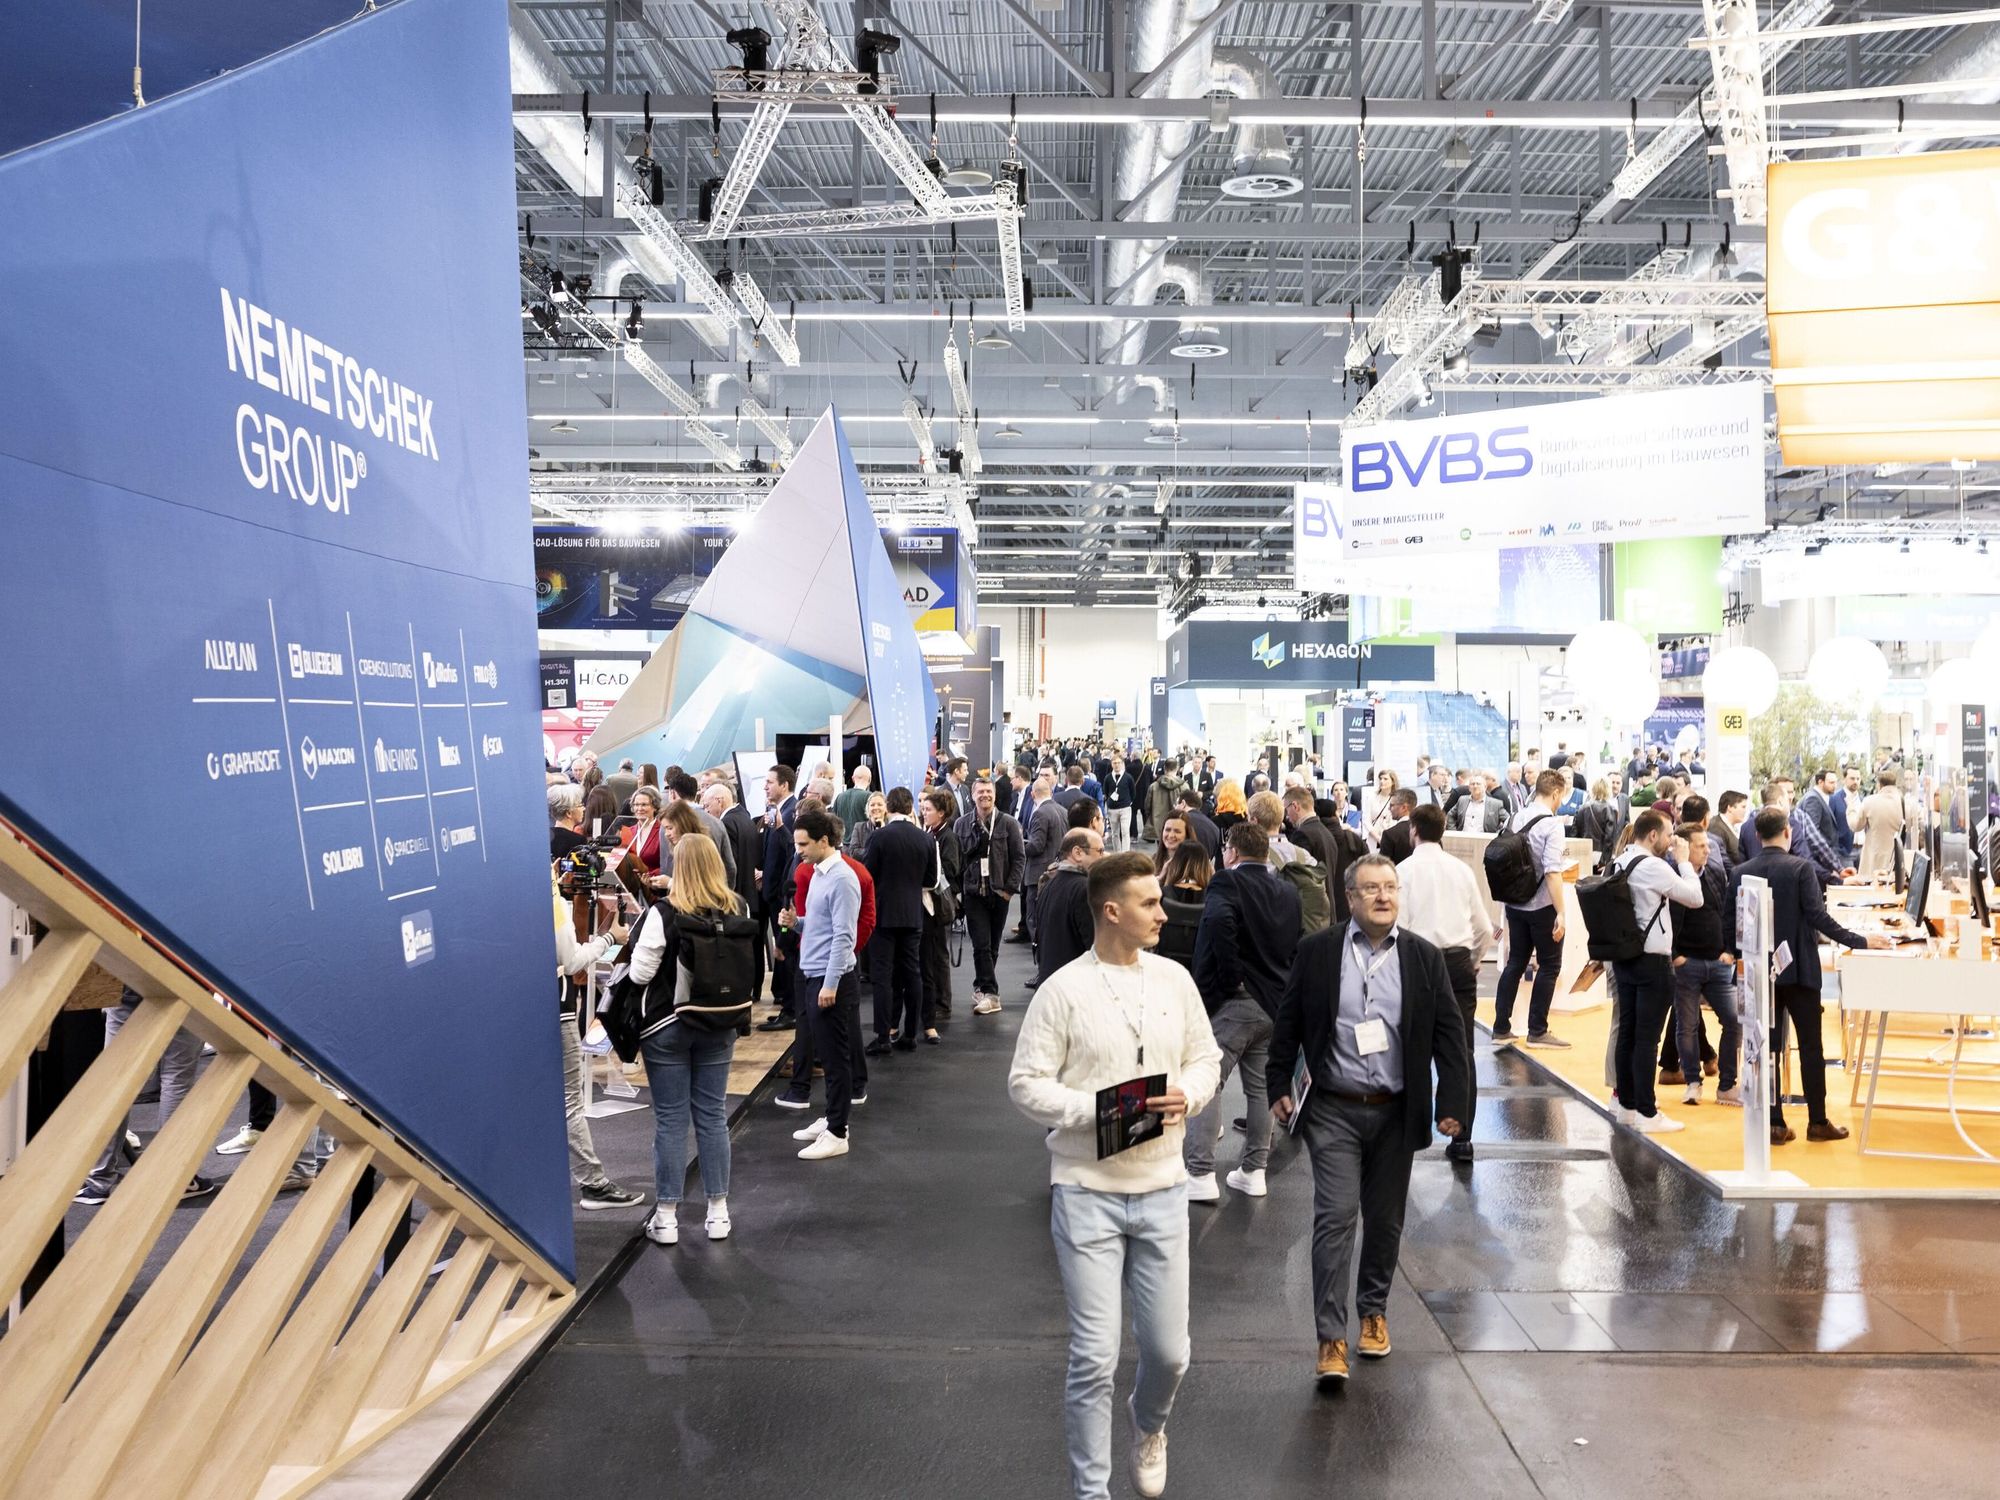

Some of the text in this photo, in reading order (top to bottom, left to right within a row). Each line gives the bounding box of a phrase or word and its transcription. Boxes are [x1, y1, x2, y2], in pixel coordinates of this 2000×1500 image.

[221, 287, 439, 461] NEMETSCHEK
[1721, 417, 1749, 435] und
[1352, 426, 1534, 493] BVBS
[1540, 444, 1750, 477] Digitalisierung im Bauwesen
[1352, 512, 1445, 528] UNSERE MITAUSSTELLER
[585, 537, 600, 548] FÜR
[602, 538, 617, 548] DAS
[619, 538, 660, 548] BAUWESEN
[703, 538, 723, 548] YOUR
[205, 639, 257, 671] ALLPLAN
[1291, 643, 1372, 659] HEXAGON
[540, 663, 568, 671] DIGITAL
[544, 678, 569, 686] H1.301
[222, 749, 282, 777] GRAPHISOFT
[317, 748, 355, 766] MAXON
[322, 846, 364, 876] SOLIBRI
